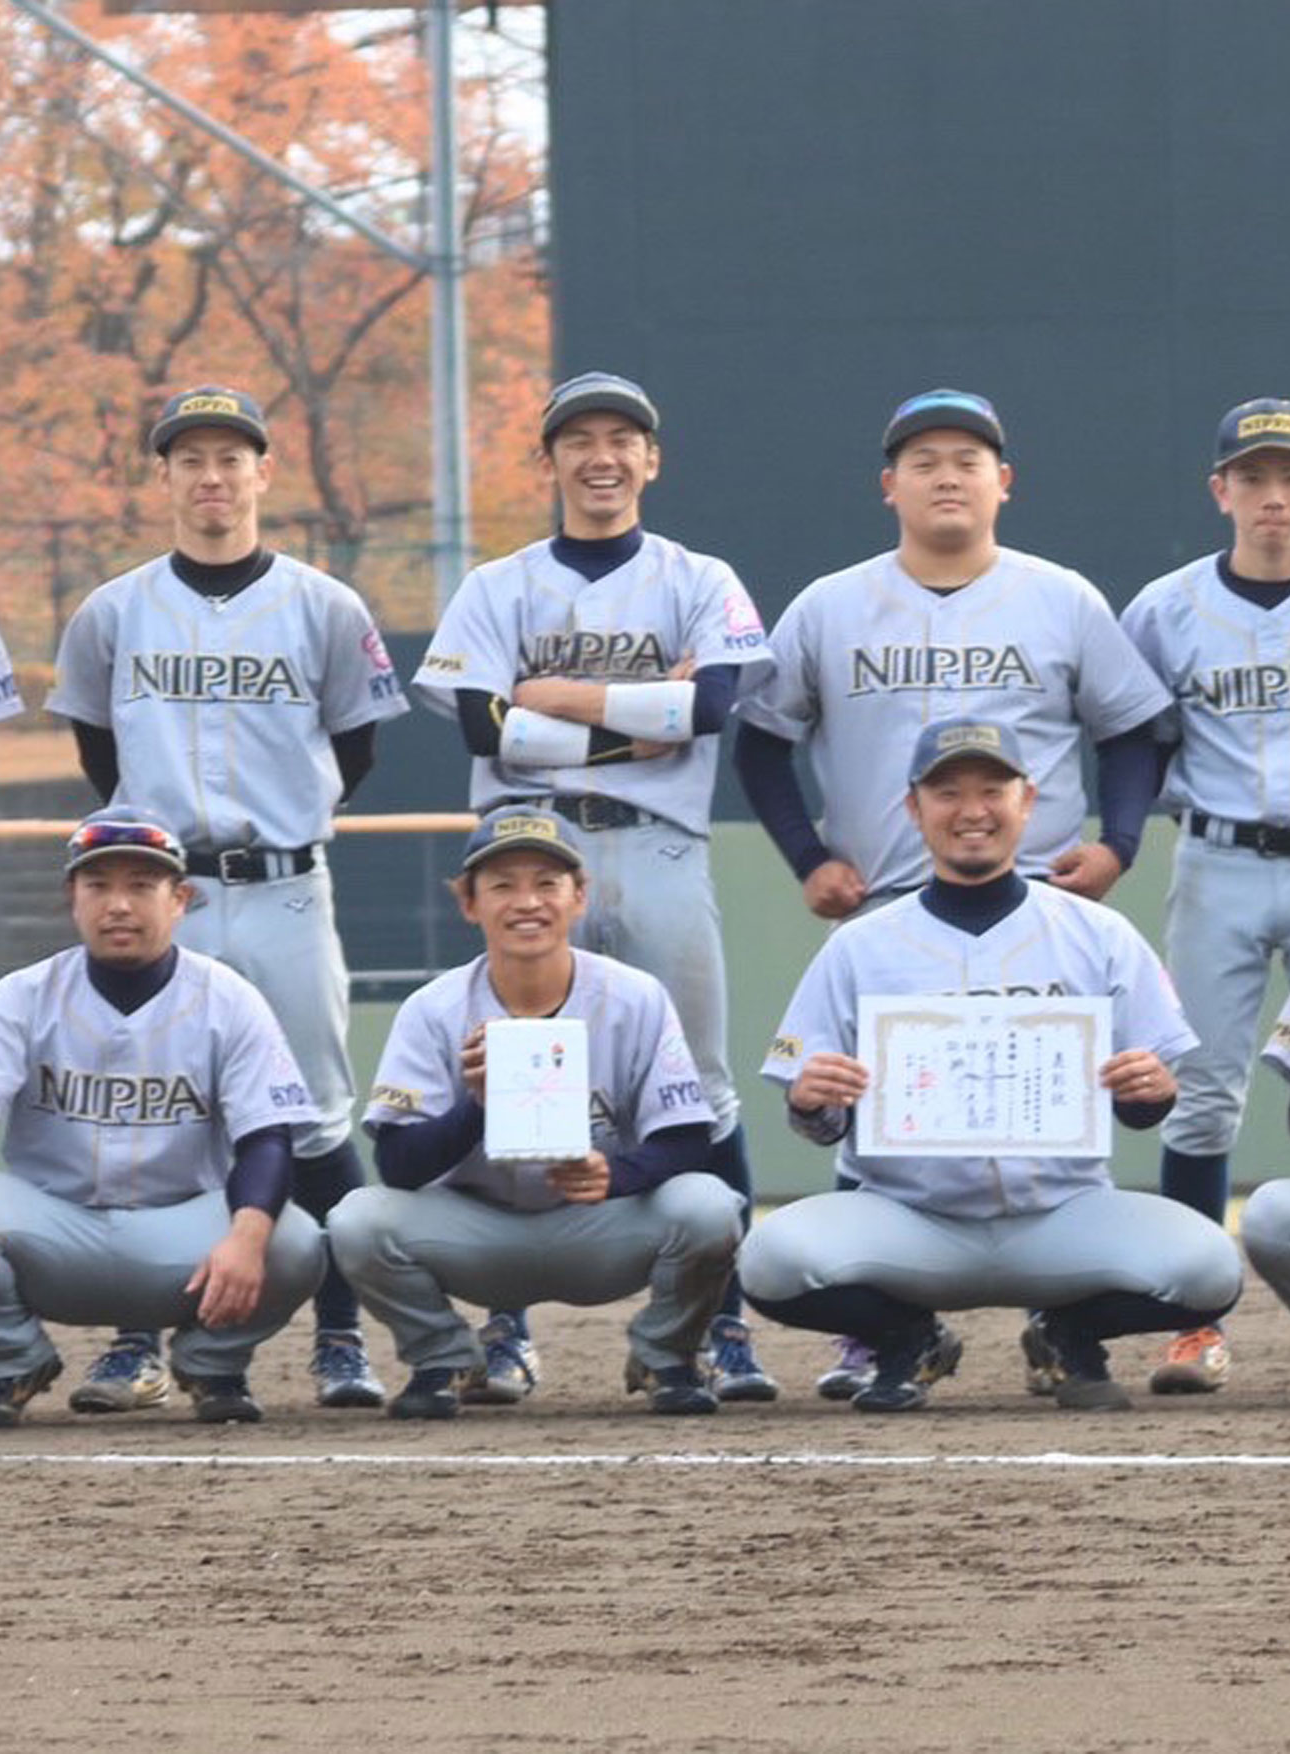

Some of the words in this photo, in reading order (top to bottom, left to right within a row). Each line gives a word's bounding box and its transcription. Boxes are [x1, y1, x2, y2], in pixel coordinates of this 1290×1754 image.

[184, 398, 234, 411] NIPPA
[131, 653, 309, 705] NIPPA
[520, 632, 669, 680] NIPPA
[849, 645, 1045, 699] NIPPA
[942, 729, 997, 744] NIPPA
[498, 818, 552, 835] NIPPA
[37, 1066, 218, 1124] NIPPA
